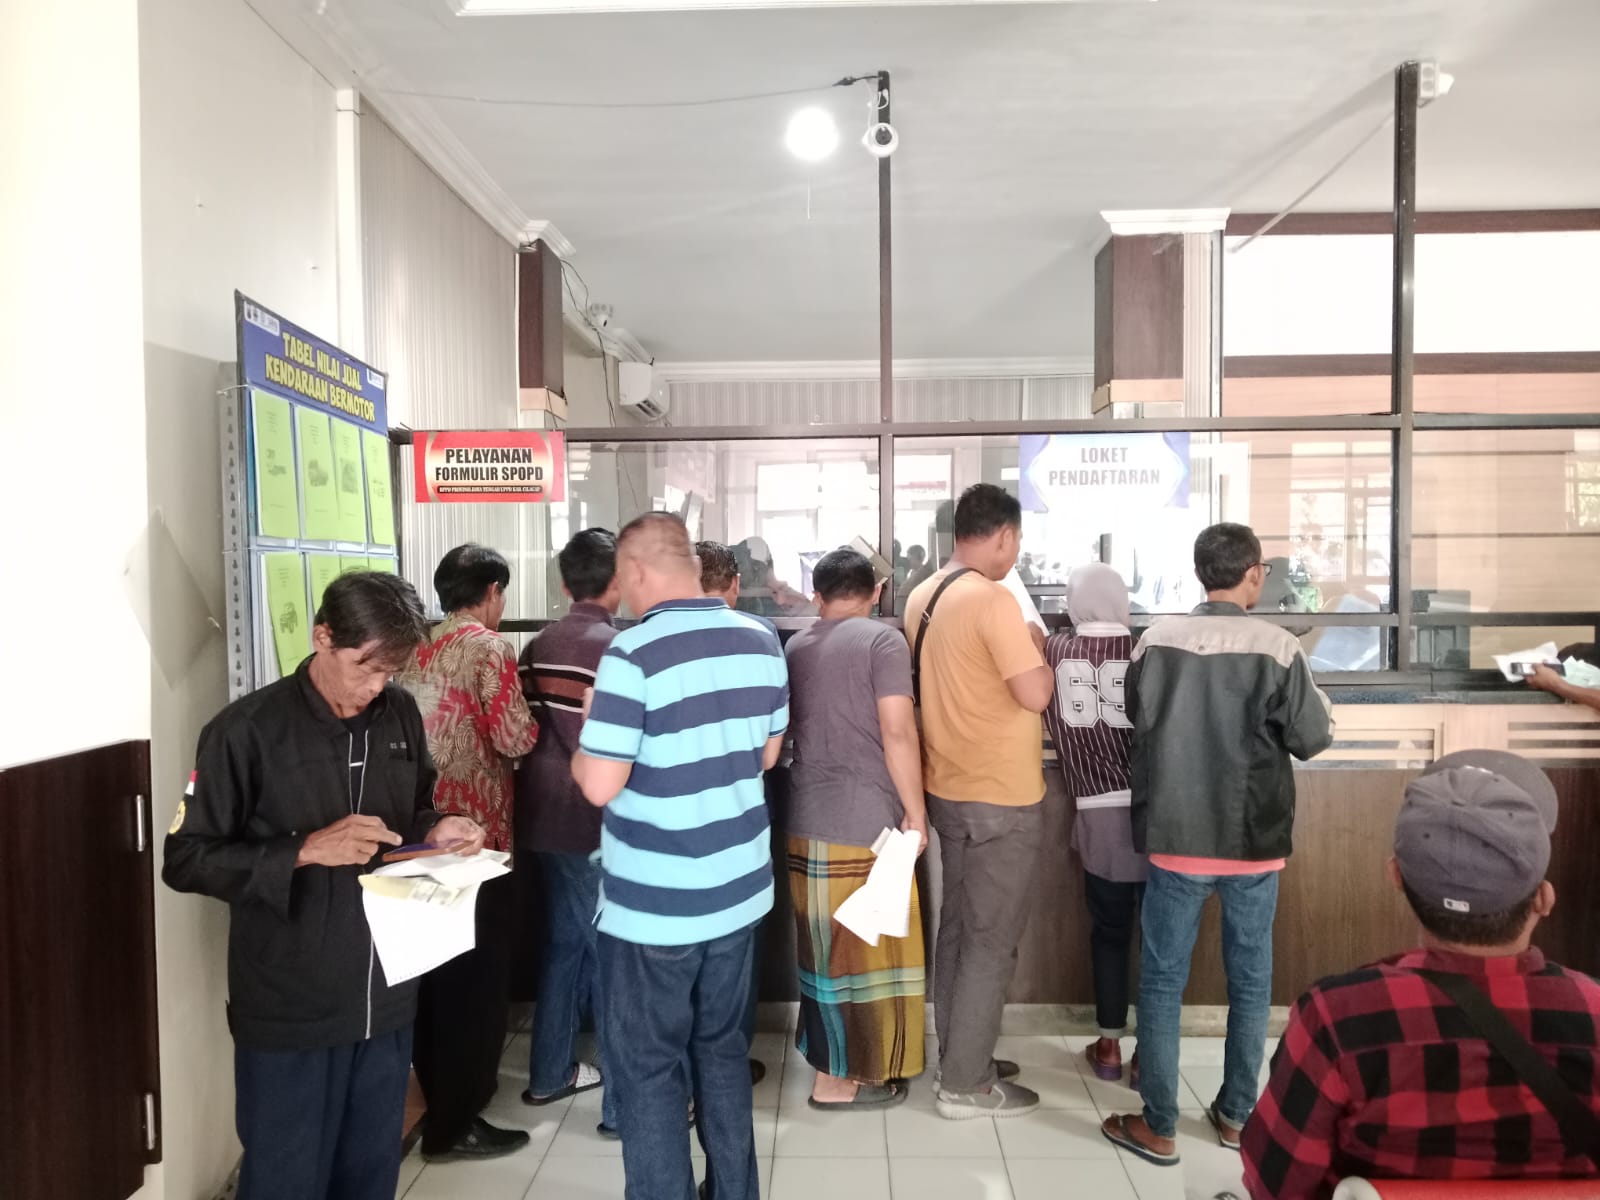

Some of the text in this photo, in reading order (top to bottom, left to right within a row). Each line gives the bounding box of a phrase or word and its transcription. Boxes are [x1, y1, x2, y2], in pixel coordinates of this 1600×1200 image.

[282, 332, 315, 368] TABEL
[316, 349, 340, 381] NILAI
[343, 365, 363, 391] JUAL
[265, 353, 328, 404] KENDARAAN
[329, 384, 376, 422] BERMOTOR
[445, 448, 532, 464] PELAYANAN
[1081, 447, 1128, 464] LOKET
[435, 466, 544, 481] FORMULIR SPOPD
[1048, 469, 1160, 486] PENDAFTARAN
